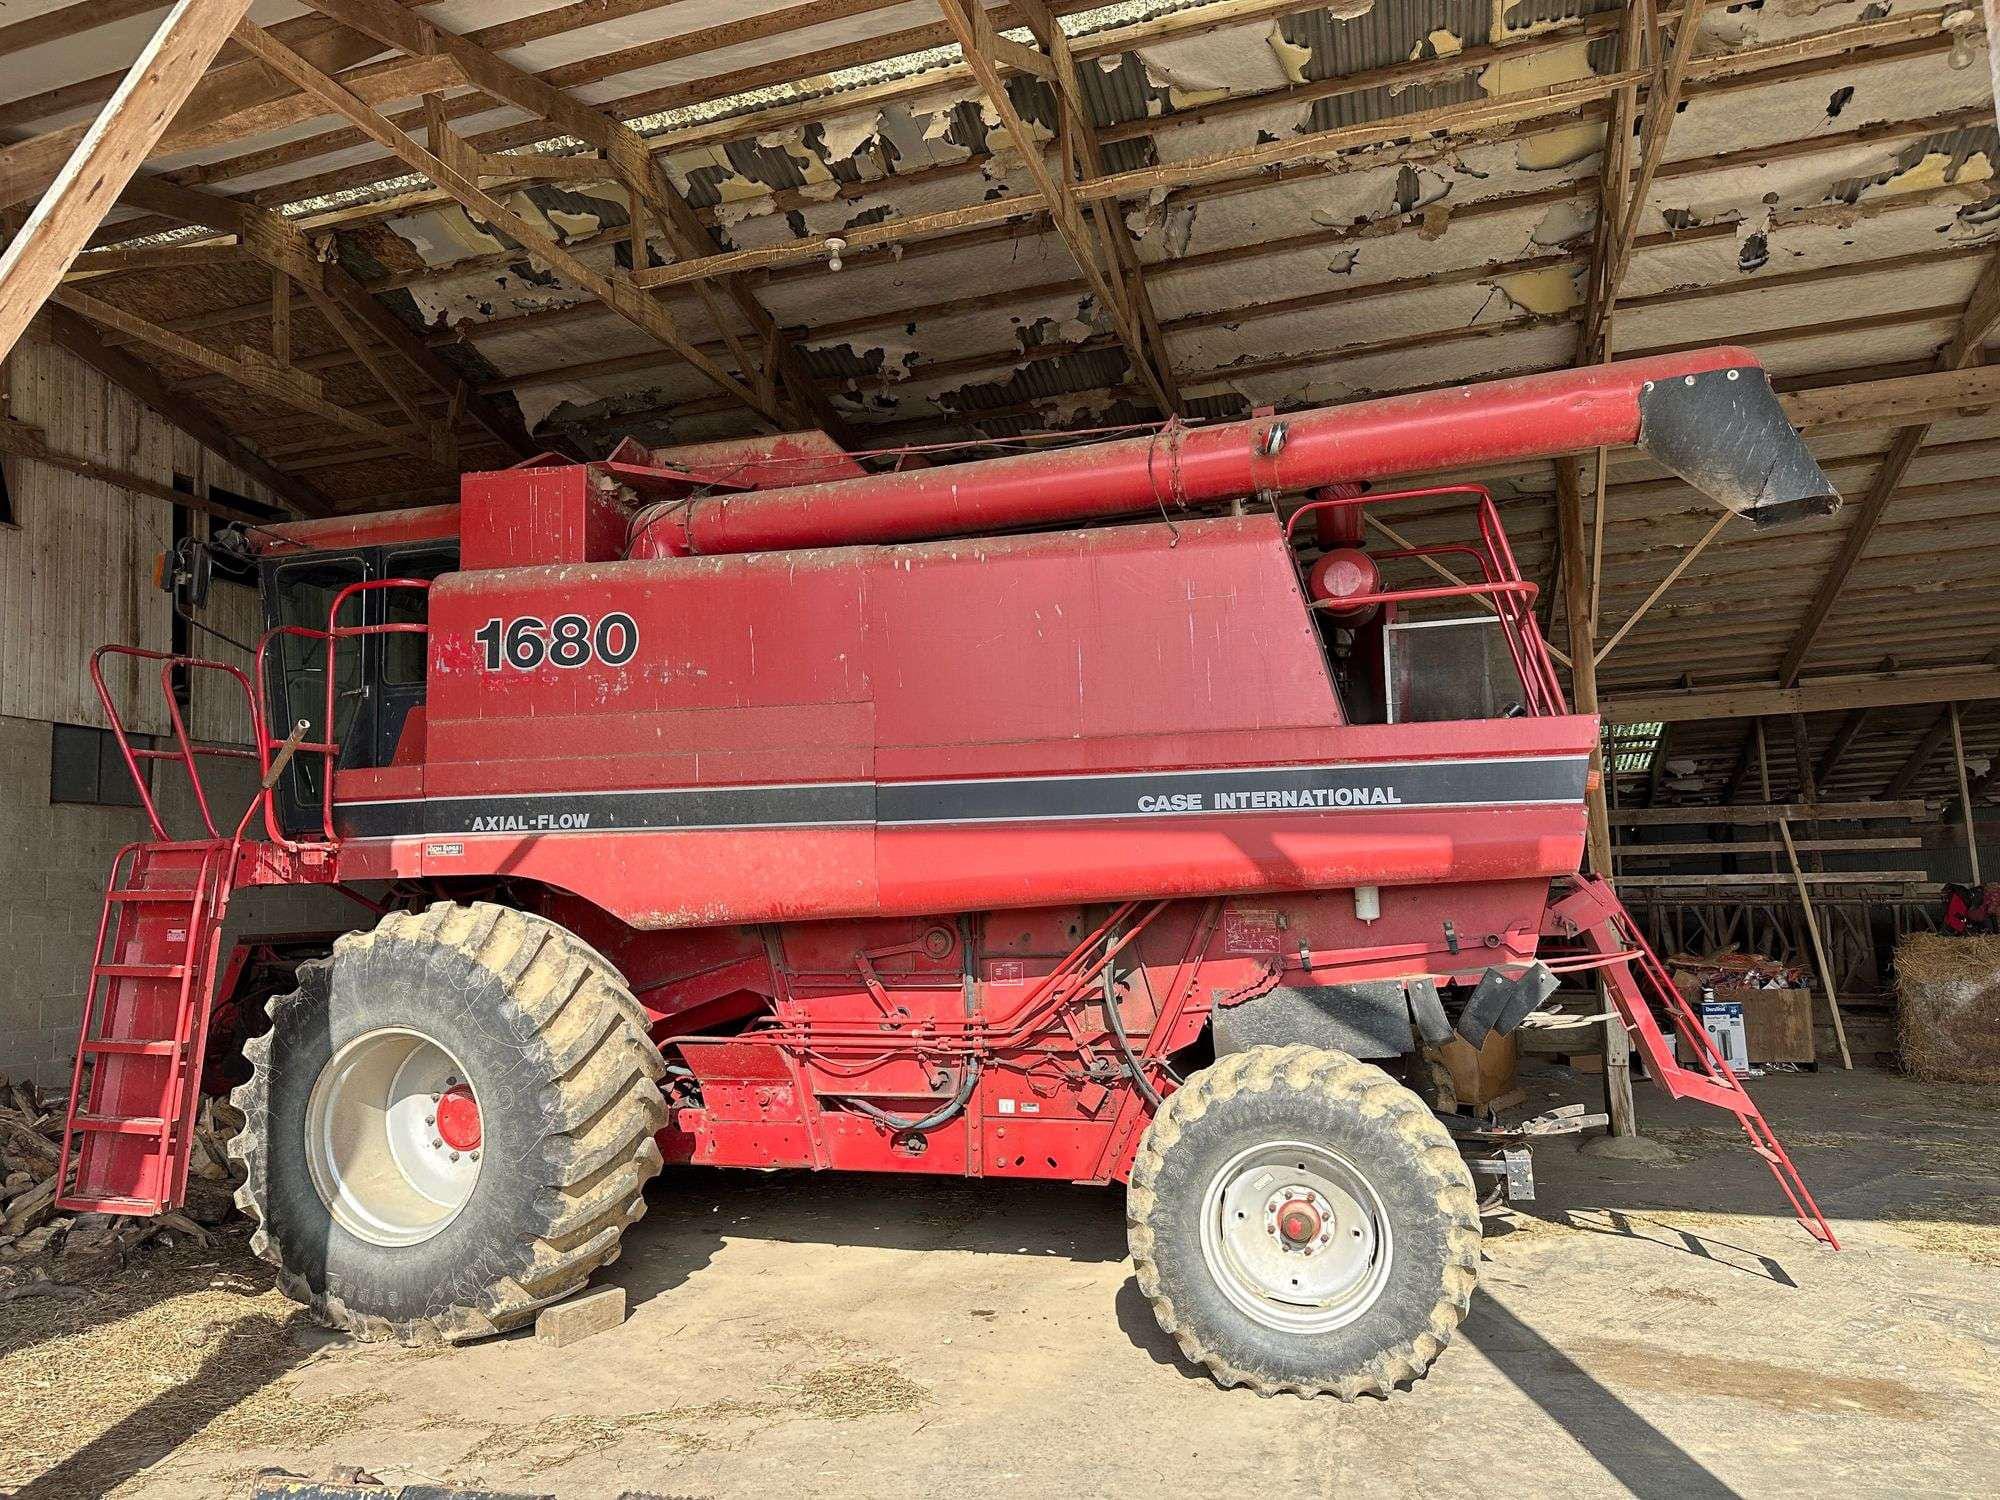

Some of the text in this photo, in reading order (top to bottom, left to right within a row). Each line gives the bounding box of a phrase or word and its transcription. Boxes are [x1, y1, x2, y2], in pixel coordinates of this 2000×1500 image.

[475, 611, 639, 671] 1680
[1137, 786, 1401, 812] CASE INTERNATIONAL
[471, 813, 590, 831] AXIAL-FLOW
